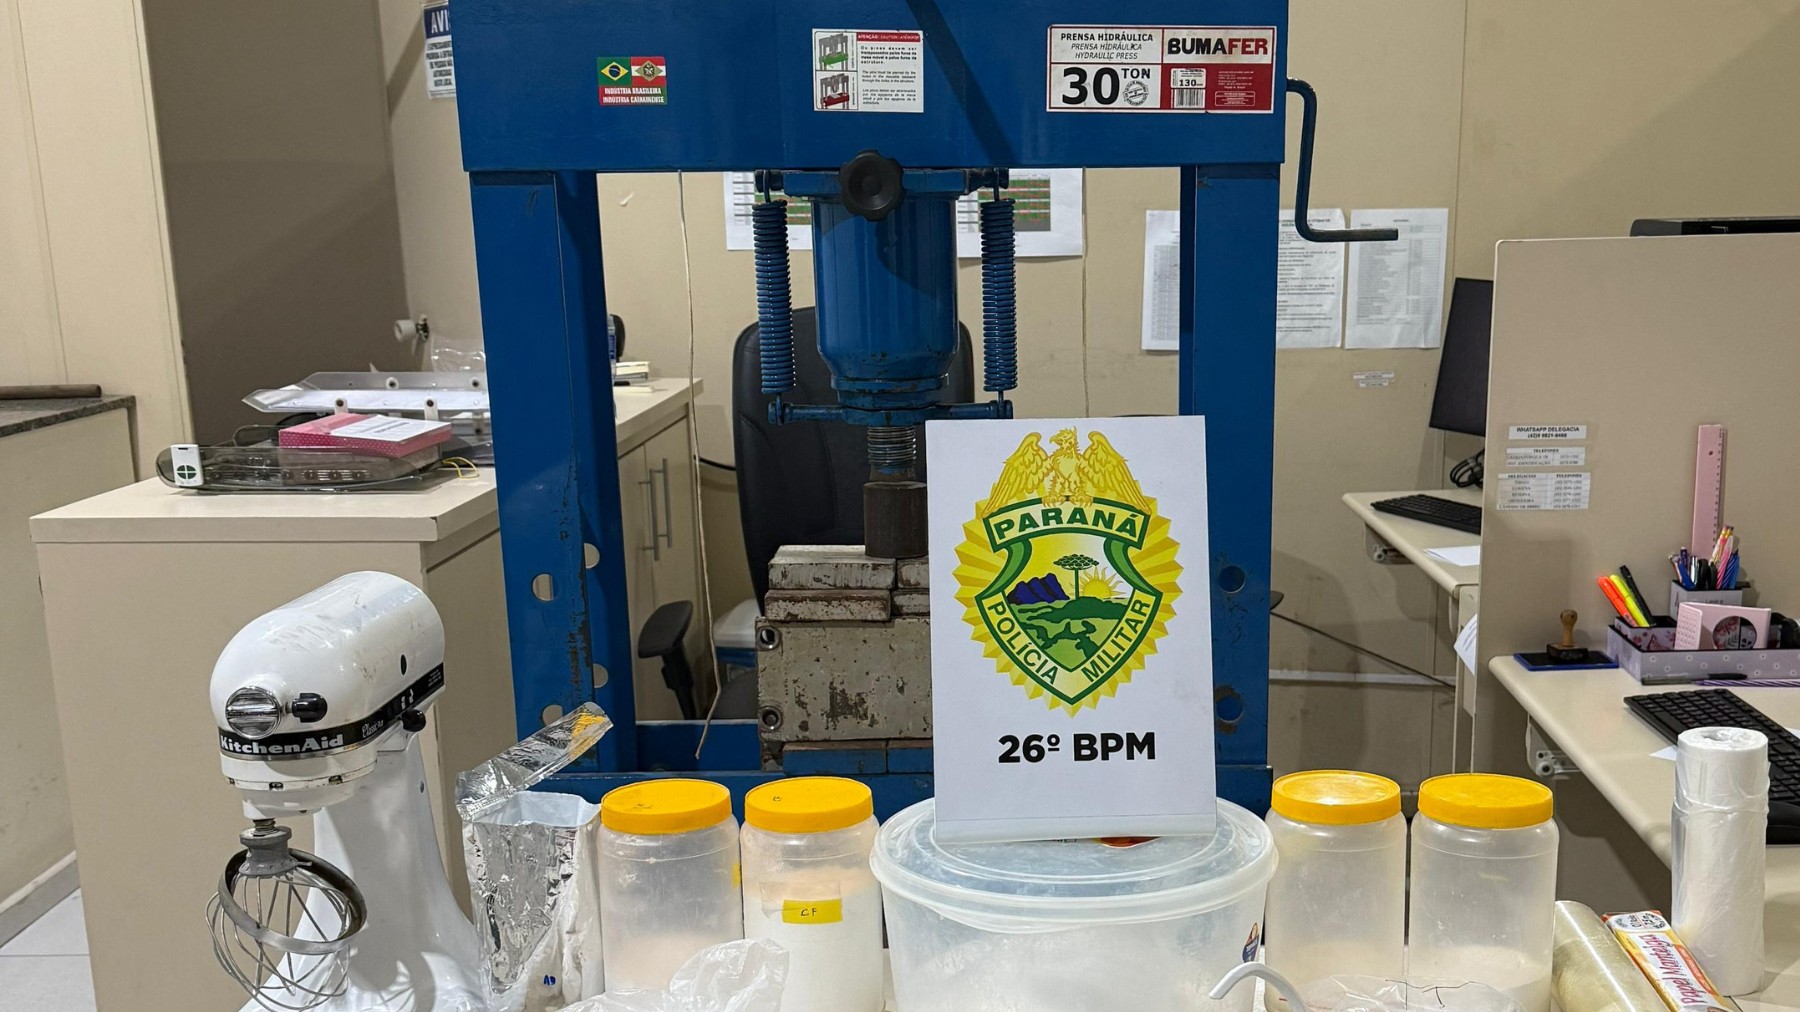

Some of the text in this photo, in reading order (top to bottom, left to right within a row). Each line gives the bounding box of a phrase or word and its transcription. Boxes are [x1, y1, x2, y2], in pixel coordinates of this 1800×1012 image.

[431, 9, 450, 34] AVI
[1061, 31, 1153, 42] PRENSA HIDRÁULICA
[1100, 42, 1142, 50] HIDRÁULICA
[1167, 38, 1268, 55] BUMAFER
[1062, 66, 1120, 105] 30
[1121, 68, 1151, 79] TON
[993, 507, 1137, 540] PARANÁ
[987, 599, 1150, 684] POLÍCIA MILITAR
[220, 734, 344, 755] KitchenAid
[998, 732, 1156, 764] 26º BPM
[1638, 934, 1687, 976] Manteiga
[1662, 977, 1708, 1004] Papel
